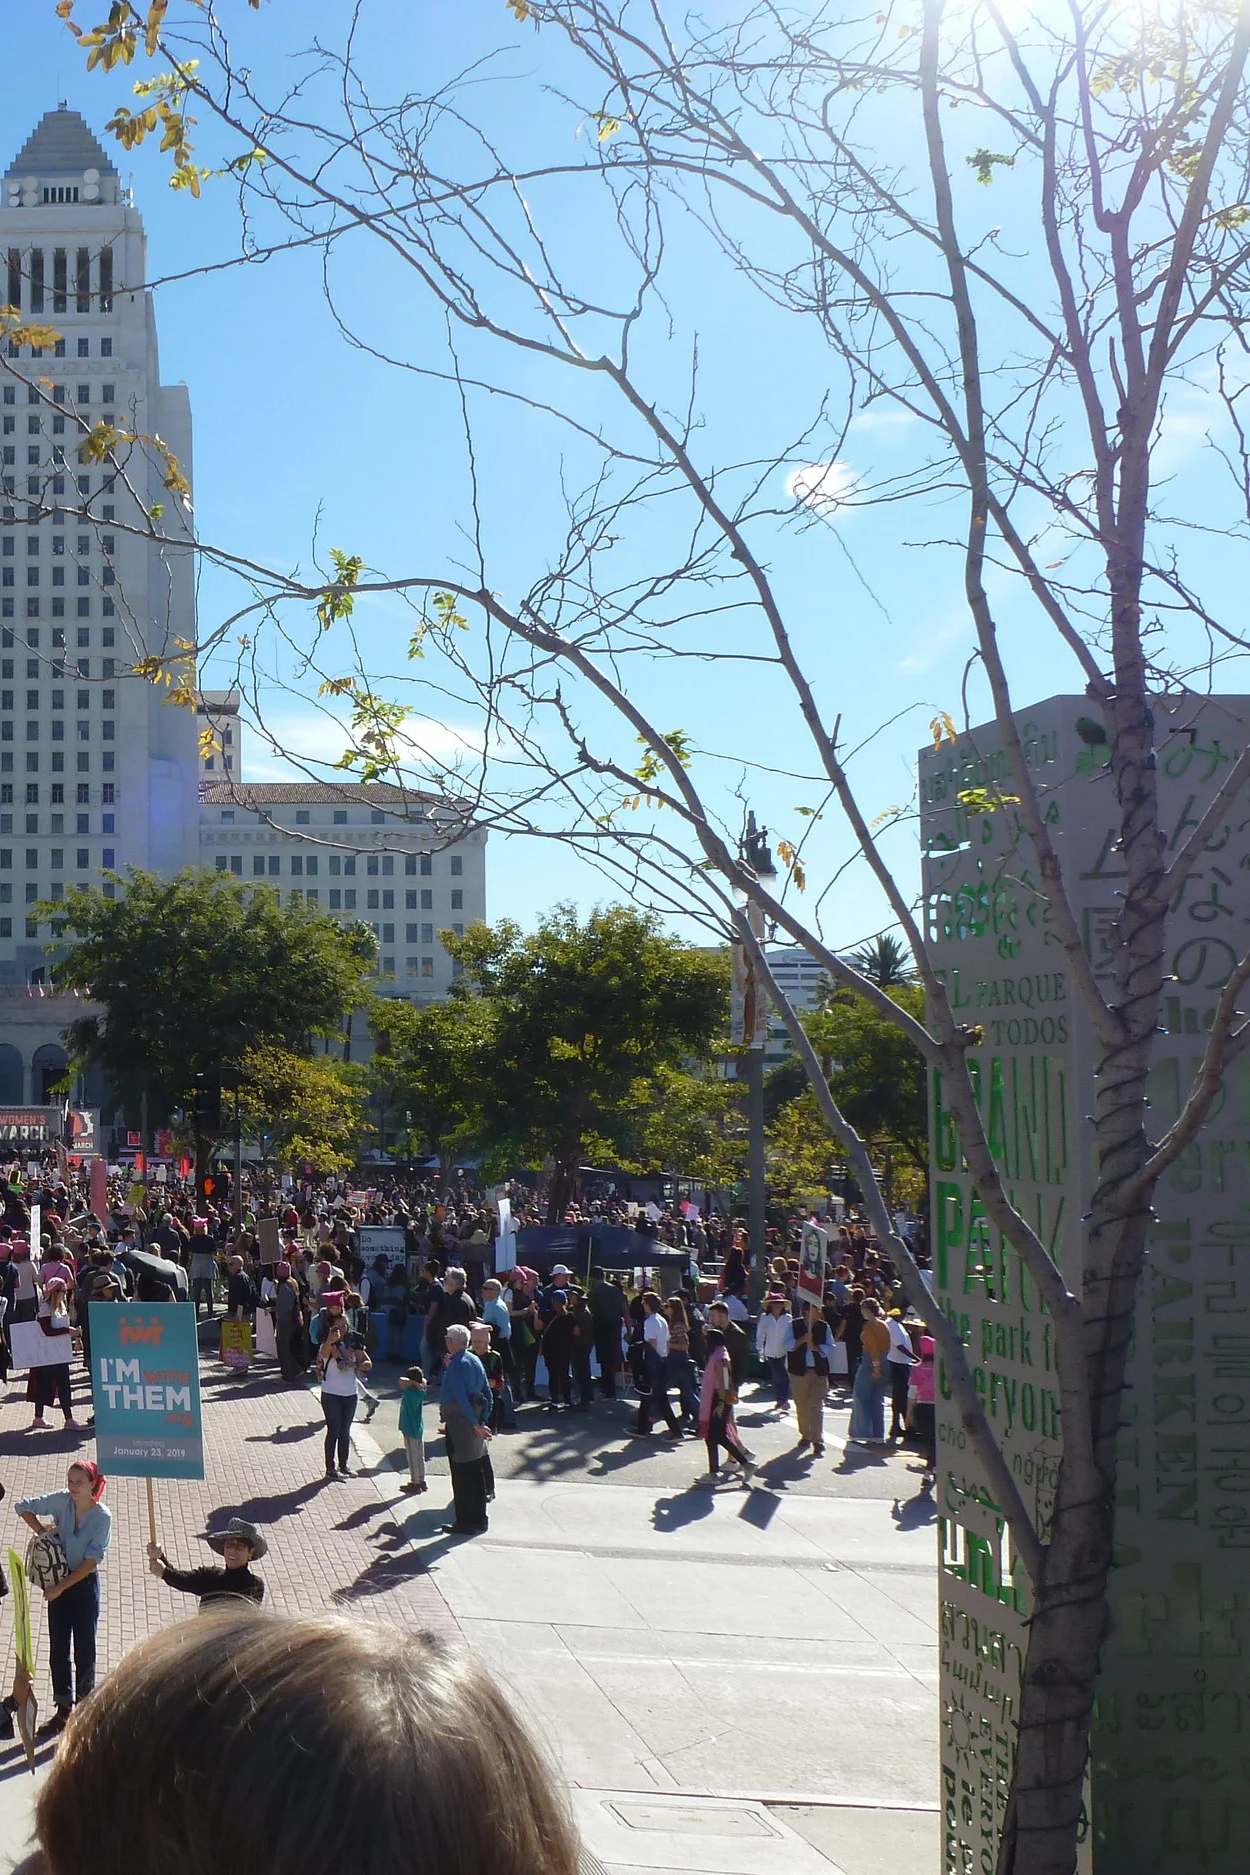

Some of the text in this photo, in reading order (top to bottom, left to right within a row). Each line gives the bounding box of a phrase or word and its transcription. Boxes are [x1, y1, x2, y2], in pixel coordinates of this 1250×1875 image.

[991, 1015, 1068, 1046] TODOS
[0, 1114, 46, 1125] WOMEN'S
[981, 1316, 1033, 1368] park
[100, 1358, 190, 1384] I'M WITH
[102, 1385, 192, 1411] THEM
[113, 1446, 148, 1458] January
[166, 1448, 186, 1458] 2019
